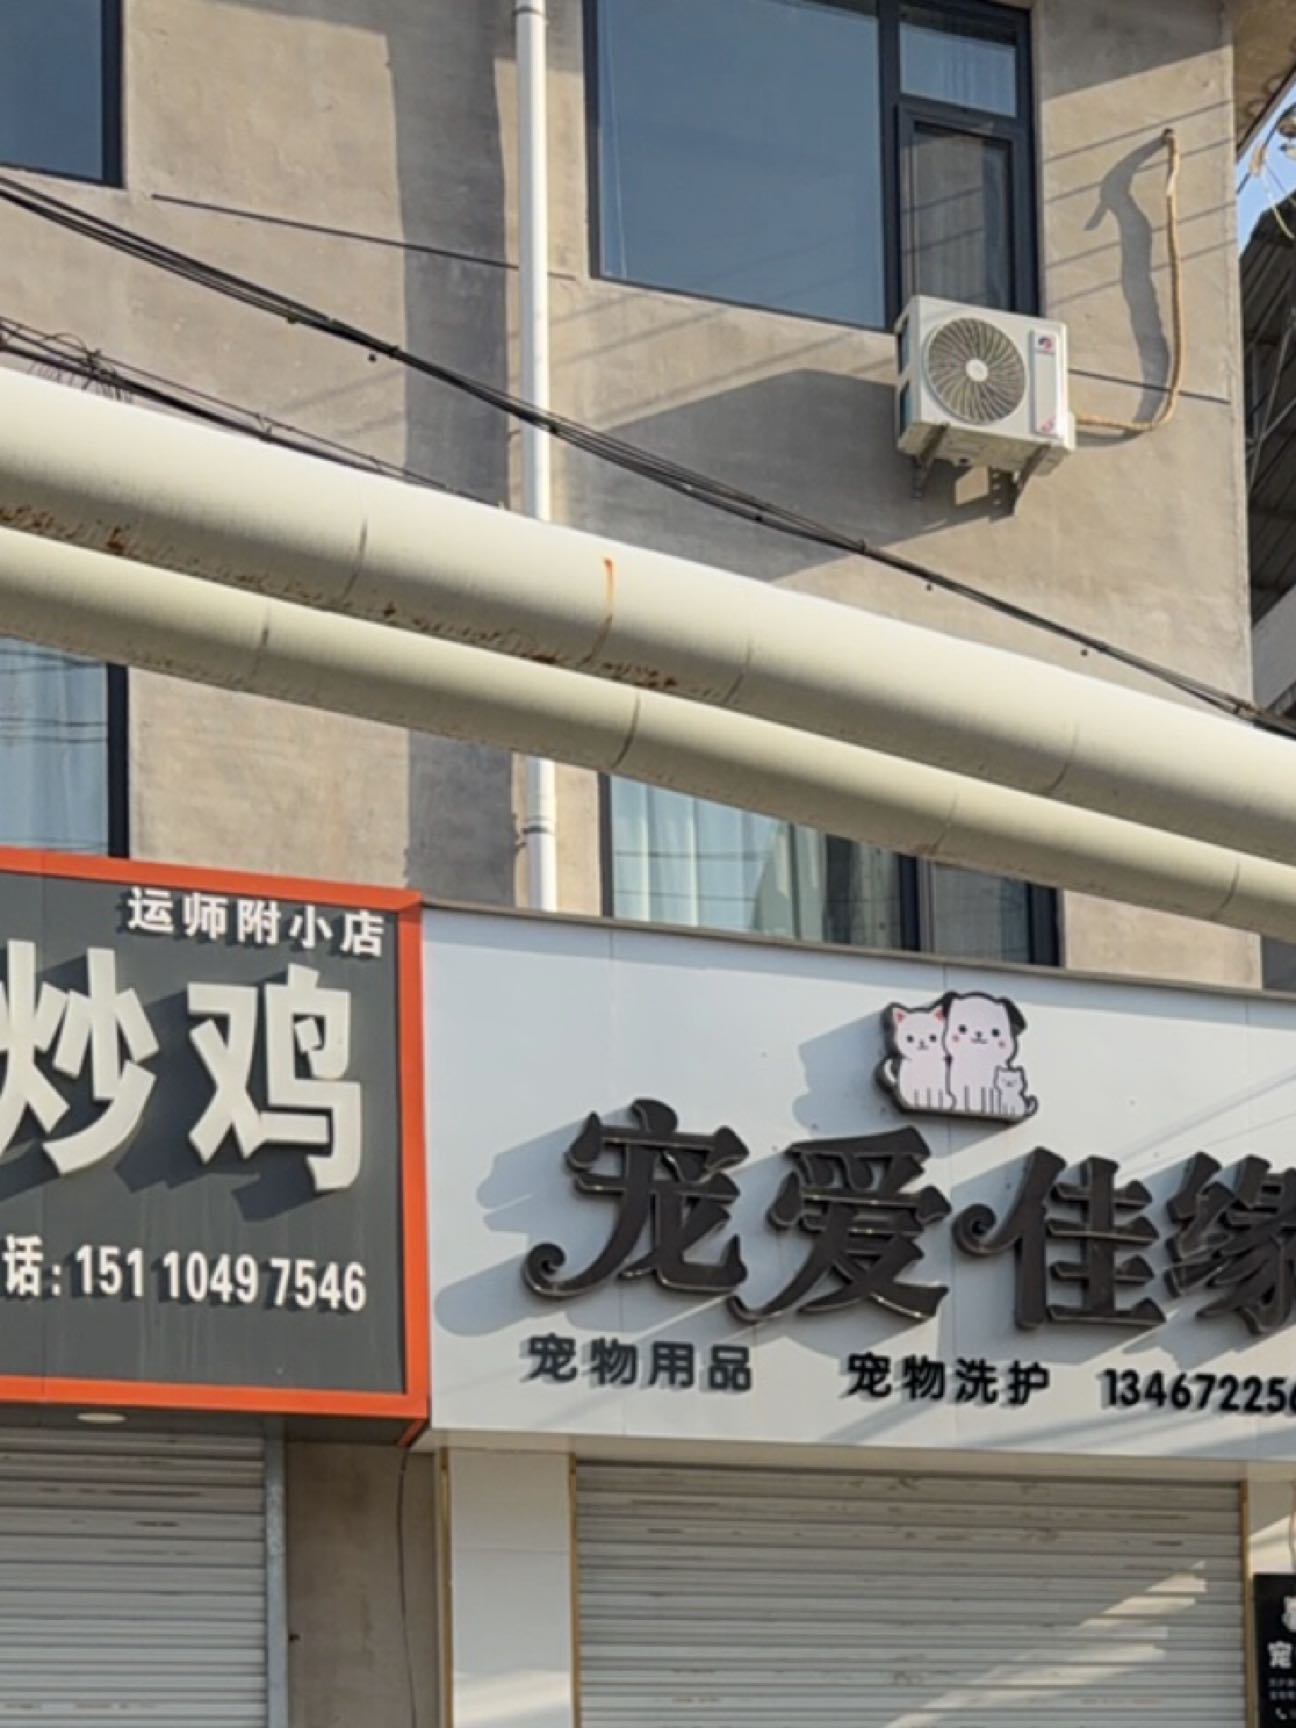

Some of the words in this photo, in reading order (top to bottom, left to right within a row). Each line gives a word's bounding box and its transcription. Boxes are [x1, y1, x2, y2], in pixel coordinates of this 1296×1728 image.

[128, 886, 385, 957] 运师附小店
[0, 940, 362, 1190] 炒鸡
[526, 1332, 753, 1393] 宠物用品
[846, 1351, 1051, 1406] 宠物洗护
